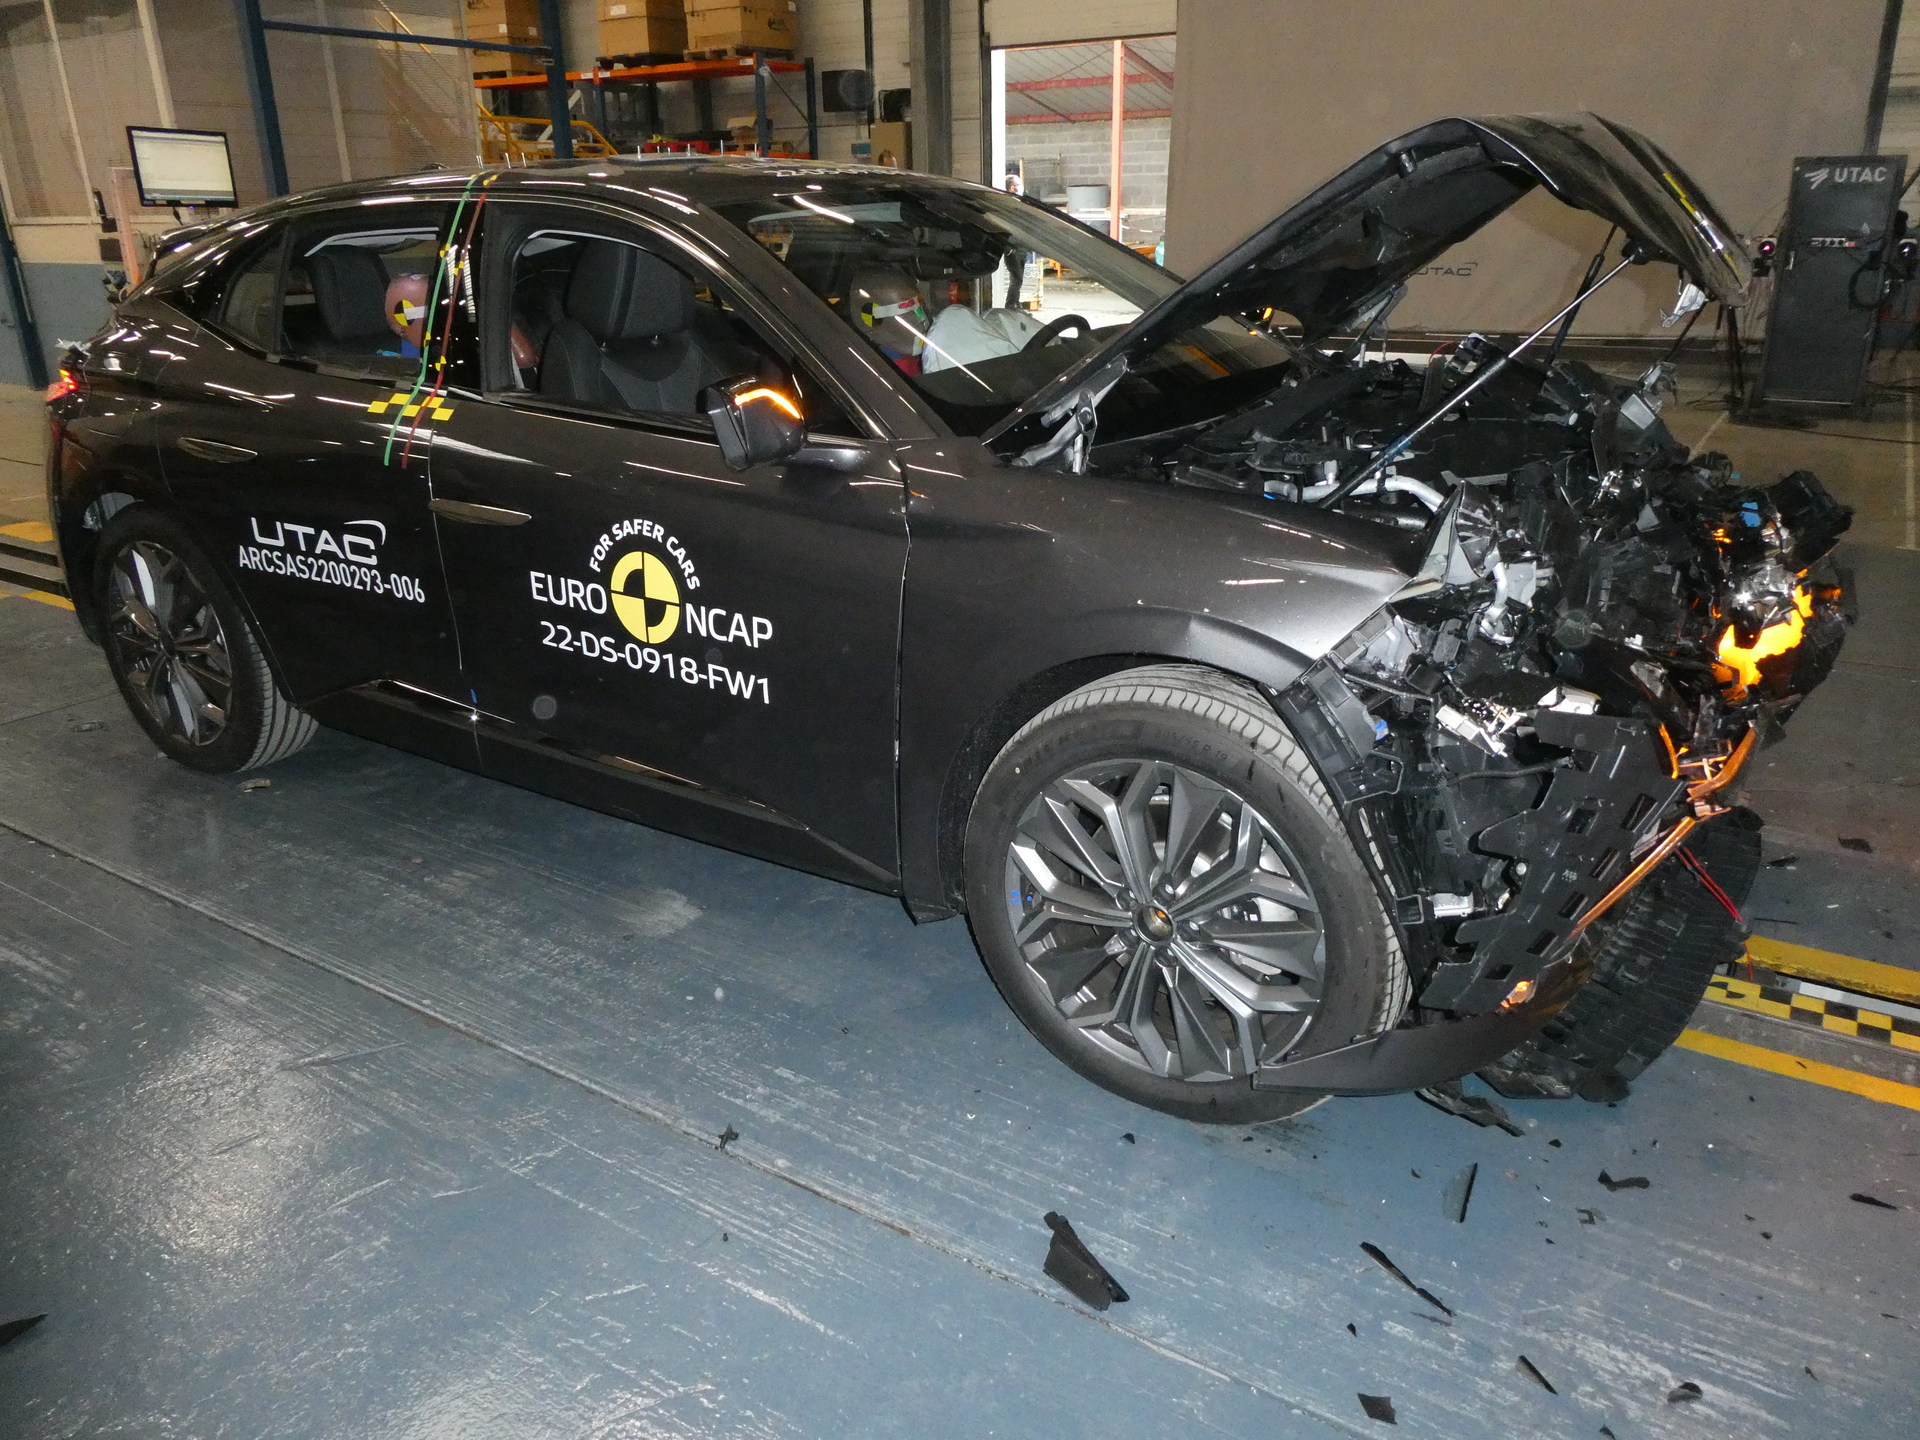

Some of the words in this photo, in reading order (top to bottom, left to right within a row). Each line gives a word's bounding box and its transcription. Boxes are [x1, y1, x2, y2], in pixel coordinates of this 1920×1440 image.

[1834, 166, 1888, 183] UTAC
[250, 516, 378, 566] UTAC
[589, 533, 614, 573] FOR
[611, 518, 665, 543] SAFER
[666, 536, 701, 590] CARS
[239, 545, 426, 604] ARCSAS2200293-006
[530, 570, 608, 615] EURO
[685, 602, 773, 649] NCAP
[540, 620, 770, 705] 22-DS-0918-FW1
